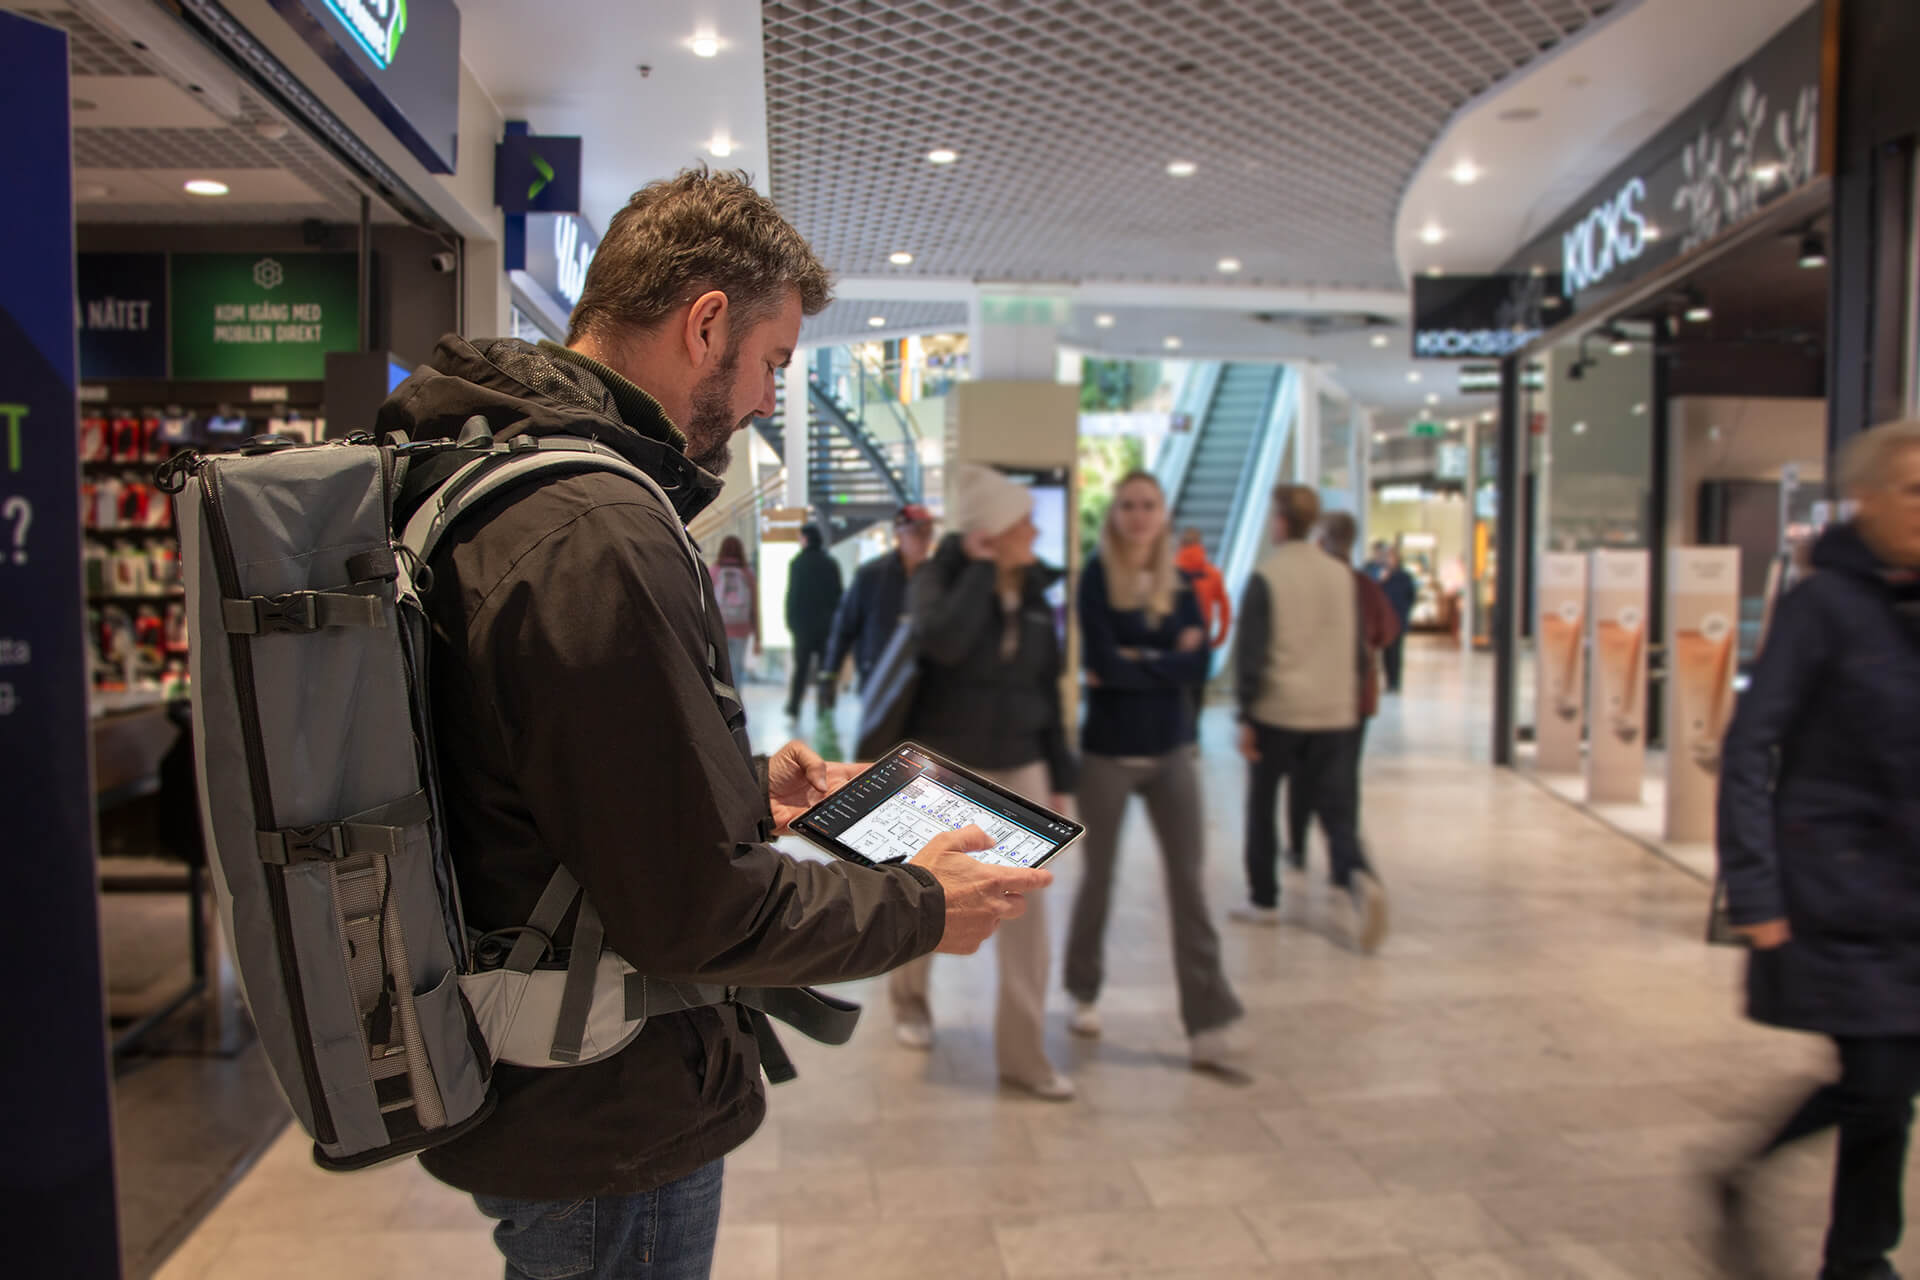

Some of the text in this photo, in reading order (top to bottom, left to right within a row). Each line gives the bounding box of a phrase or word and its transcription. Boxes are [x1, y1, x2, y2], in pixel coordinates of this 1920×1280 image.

[1563, 177, 1645, 298] KICKS
[88, 297, 150, 330] NÄTET
[214, 300, 321, 322] KOM IGÅNG MED
[213, 324, 322, 343] MOBILEN DIREKT
